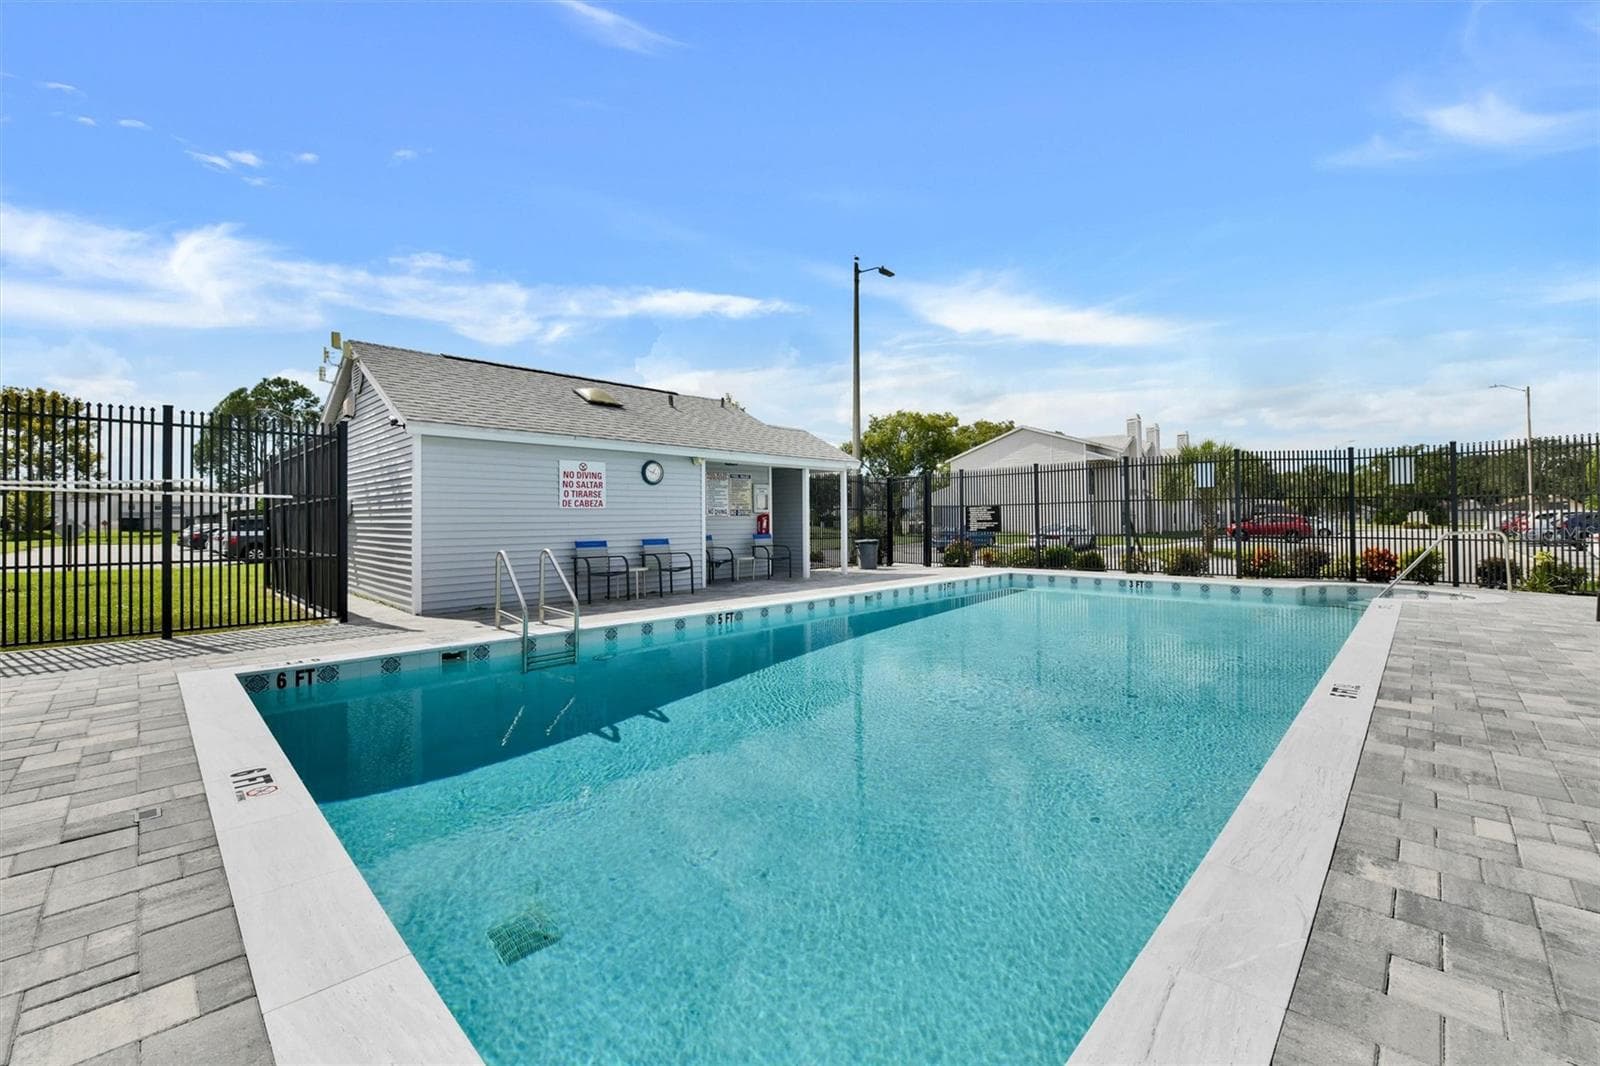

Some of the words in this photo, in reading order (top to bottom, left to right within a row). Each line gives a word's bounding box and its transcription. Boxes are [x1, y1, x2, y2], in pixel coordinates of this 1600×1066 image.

[563, 471, 574, 479] NO
[577, 471, 602, 480] DIVING
[576, 481, 604, 489] SALTAR
[564, 490, 569, 498] O
[571, 490, 602, 498] TIRARSE
[1129, 580, 1134, 588] 3
[1136, 580, 1144, 588] FT
[718, 613, 723, 625] 5
[725, 612, 734, 625] FT
[277, 672, 287, 689] 6
[296, 668, 315, 687] FT
[230, 767, 267, 777] 6
[232, 774, 274, 789] FT
